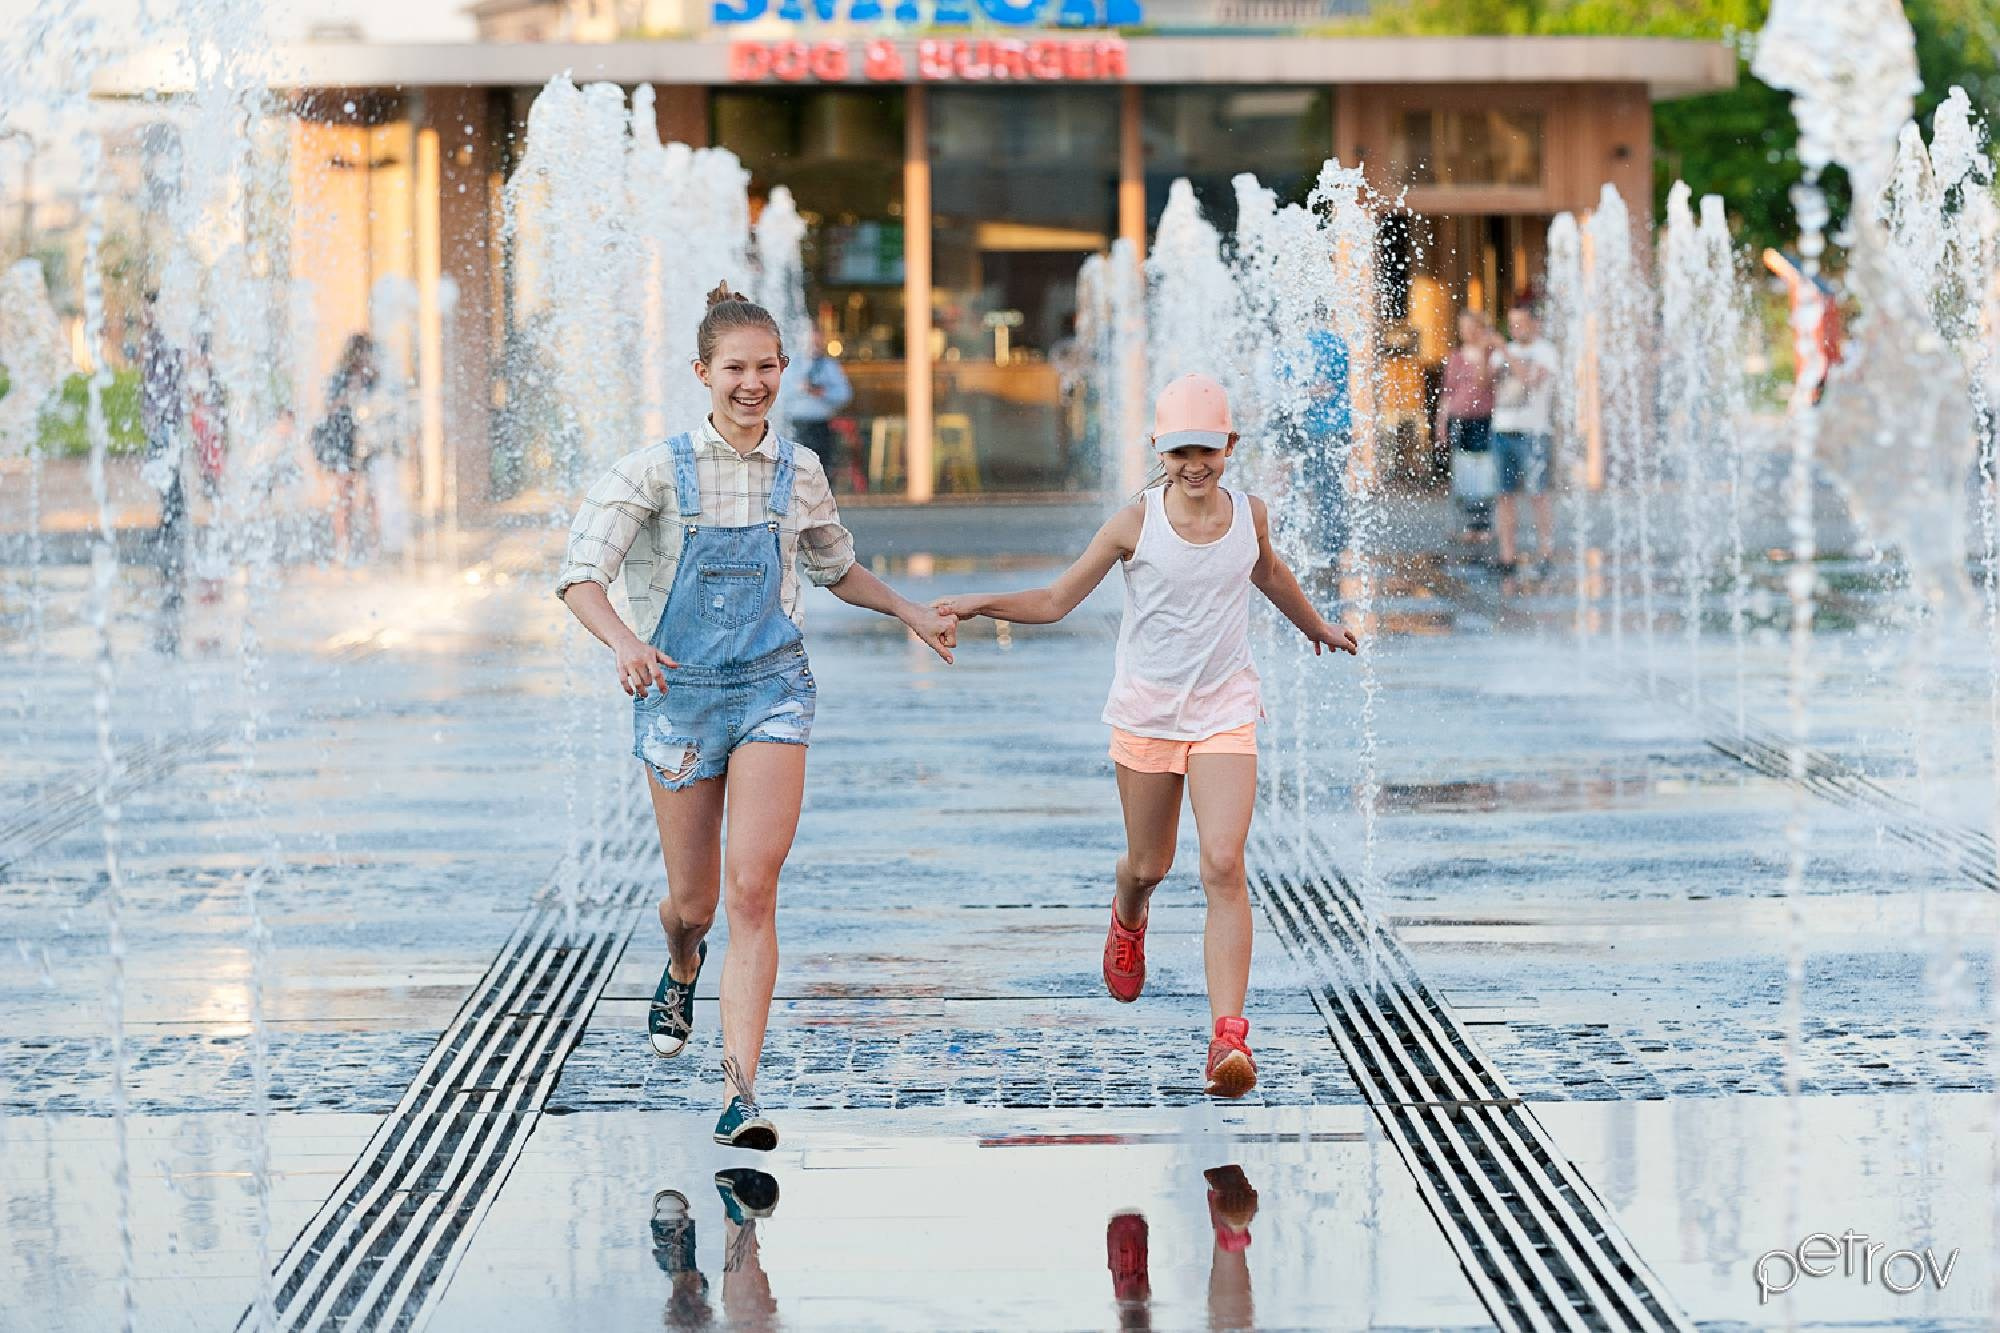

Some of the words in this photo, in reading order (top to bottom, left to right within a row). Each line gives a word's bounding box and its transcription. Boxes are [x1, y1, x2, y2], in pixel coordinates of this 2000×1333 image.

[730, 38, 850, 81] DOG
[864, 38, 905, 81] &
[919, 38, 1128, 81] BURGER
